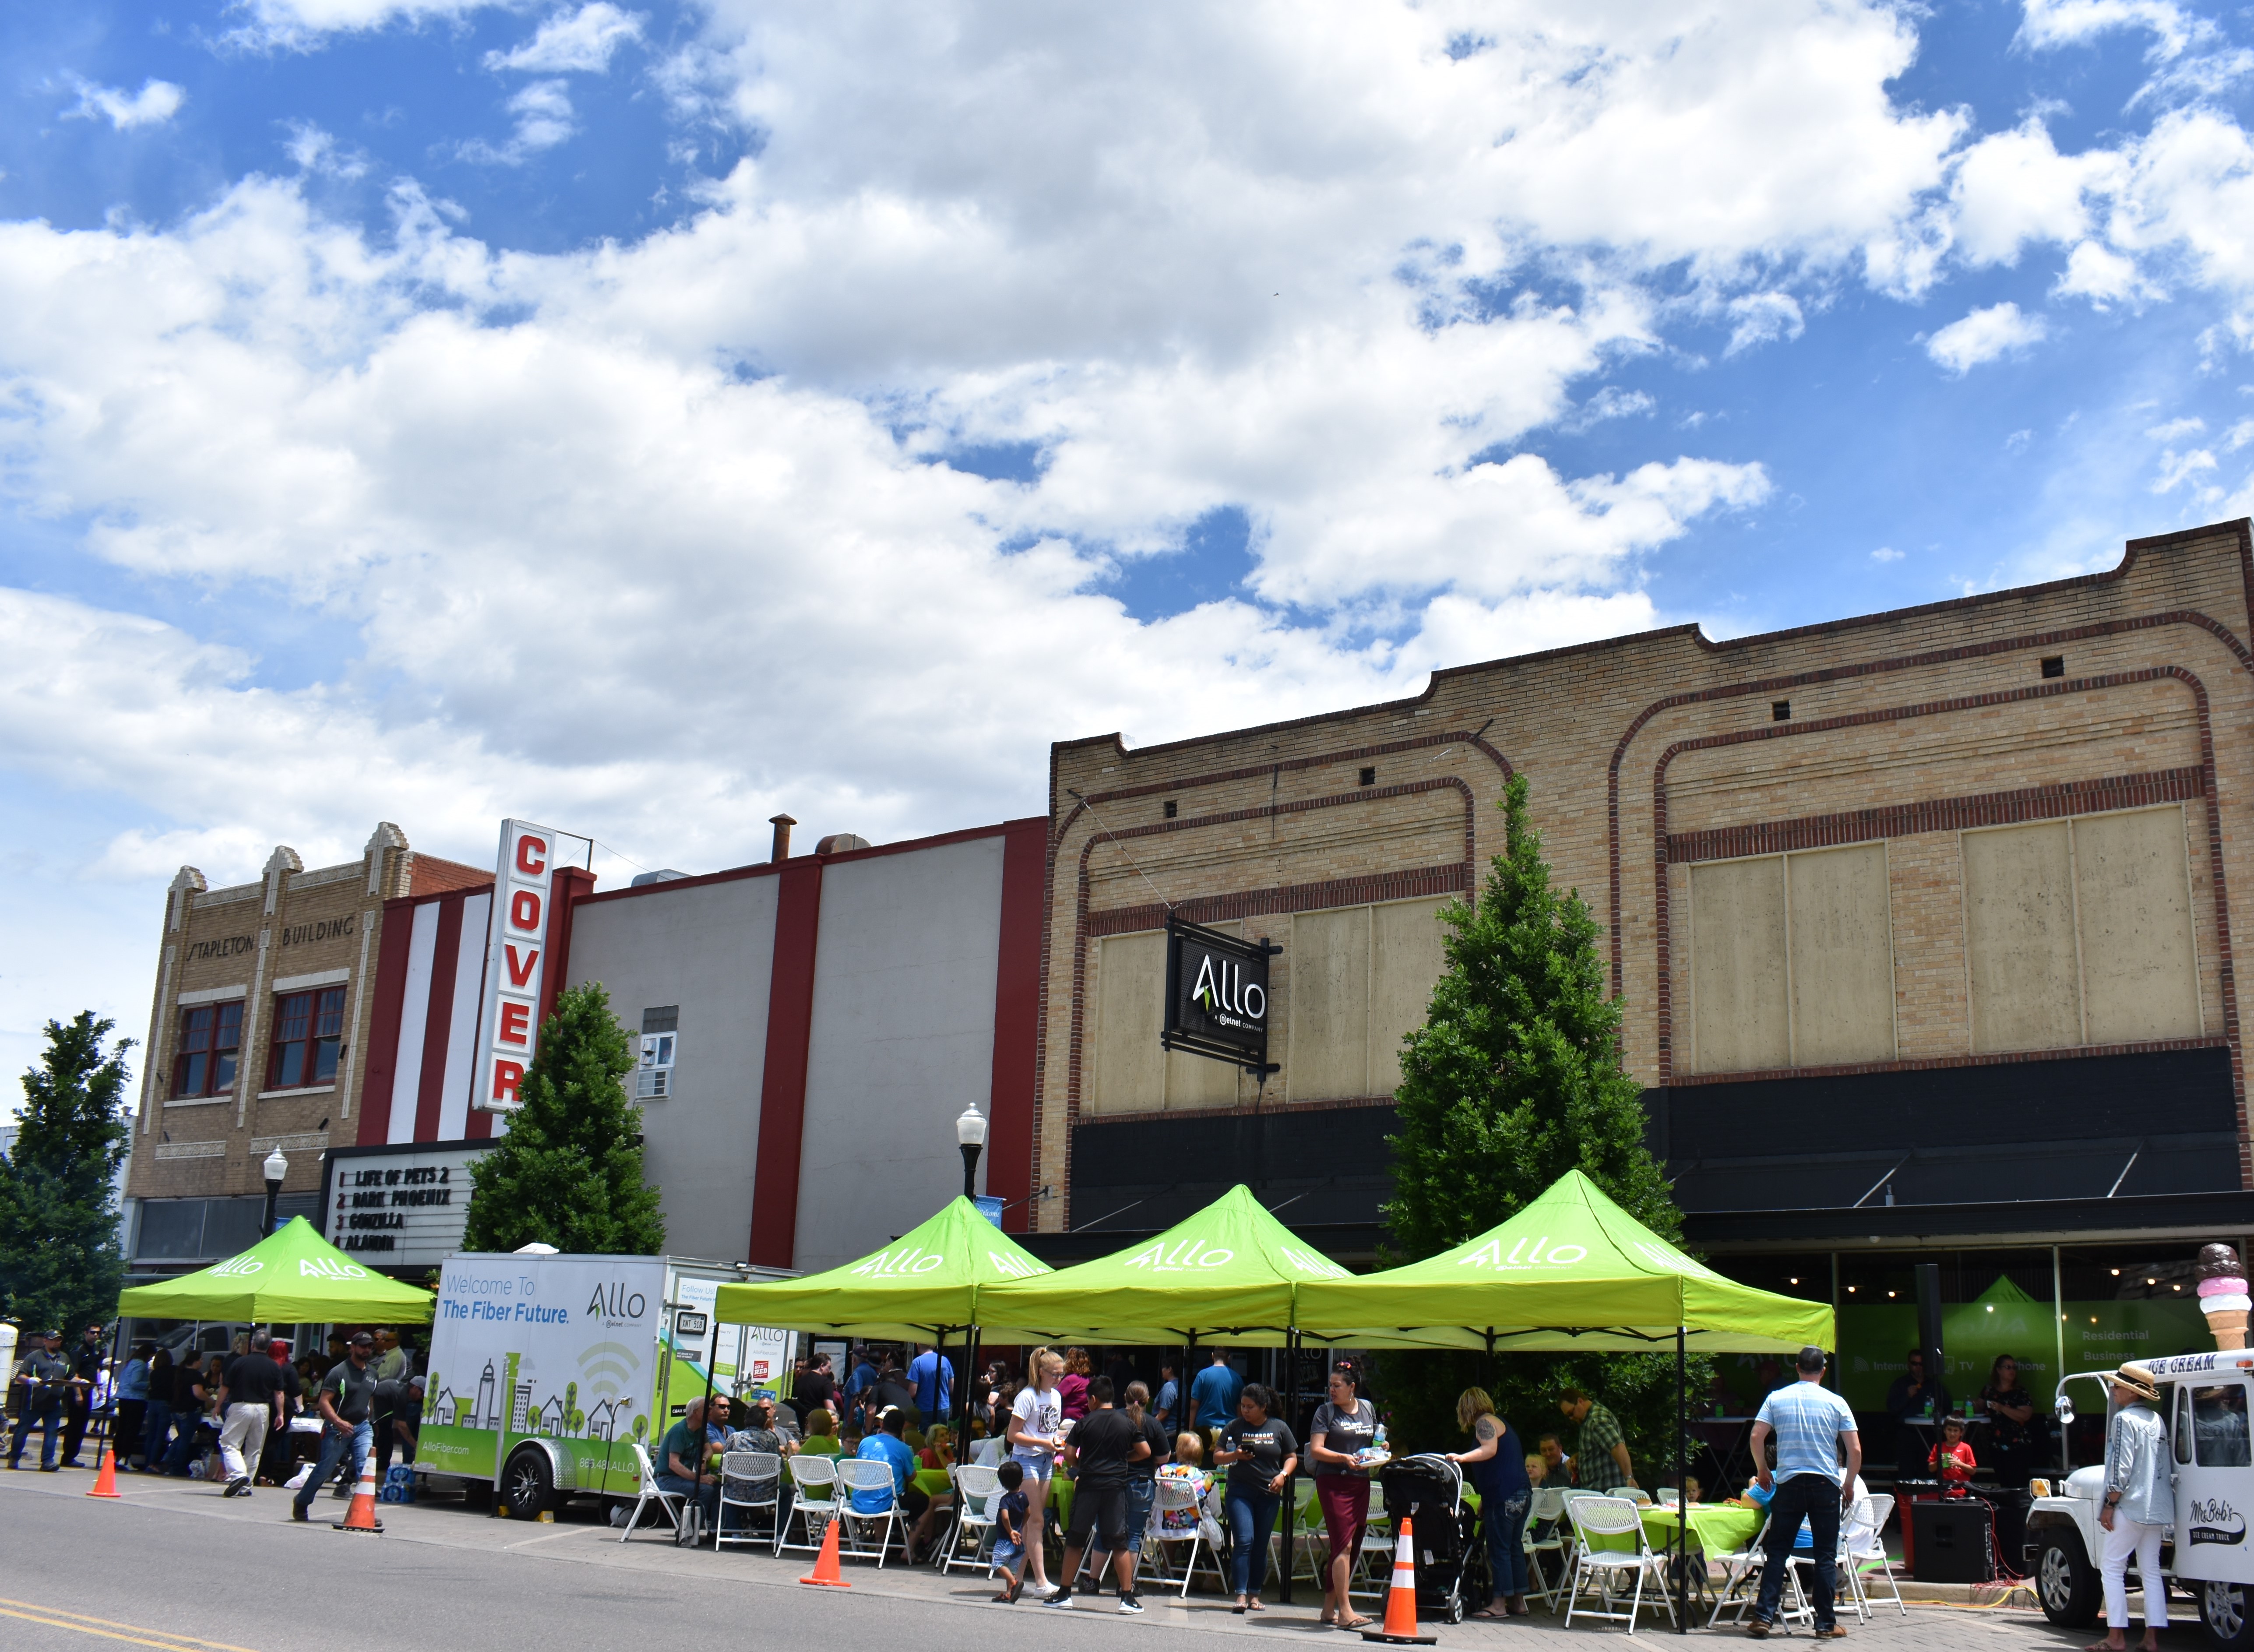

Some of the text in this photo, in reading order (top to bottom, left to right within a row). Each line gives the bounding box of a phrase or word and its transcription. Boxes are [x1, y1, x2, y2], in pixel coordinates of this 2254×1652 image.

[186, 917, 354, 961] STAPLETON BUILDING
[493, 835, 546, 1102] COVER
[1193, 955, 1265, 1019] Allo
[1220, 1013, 1241, 1027] nelnet
[1243, 1022, 1263, 1032] COMPANY
[355, 1170, 382, 1186] LIFE
[385, 1169, 401, 1185] OF
[404, 1167, 436, 1185] PETS
[439, 1167, 449, 1184] 2
[336, 1189, 451, 1209] 2 DARK PHOENIX
[335, 1212, 403, 1230] 3 GODZILLA
[851, 1248, 943, 1276] Allo
[1124, 1240, 1233, 1269] Allo
[1458, 1236, 1587, 1268] Allo
[207, 1256, 264, 1275] Allo
[300, 1257, 367, 1278] Allo
[447, 1275, 534, 1296] Welcome To
[683, 1285, 704, 1293] Follow
[586, 1282, 645, 1320] Allo
[443, 1300, 569, 1324] The Fiber Future.
[682, 1320, 702, 1329] XNT 518
[751, 1327, 783, 1342] Allo
[2082, 1330, 2149, 1341] Residential
[1874, 1362, 1910, 1370] Interne
[1959, 1362, 1974, 1370] TV
[2084, 1352, 2135, 1361] Business
[2148, 1354, 2217, 1375] ICE CREAM
[422, 1441, 469, 1455] AlloFiber.com
[2206, 1498, 2233, 1523] Bob's
[2216, 1533, 2230, 1541] TRUCK
